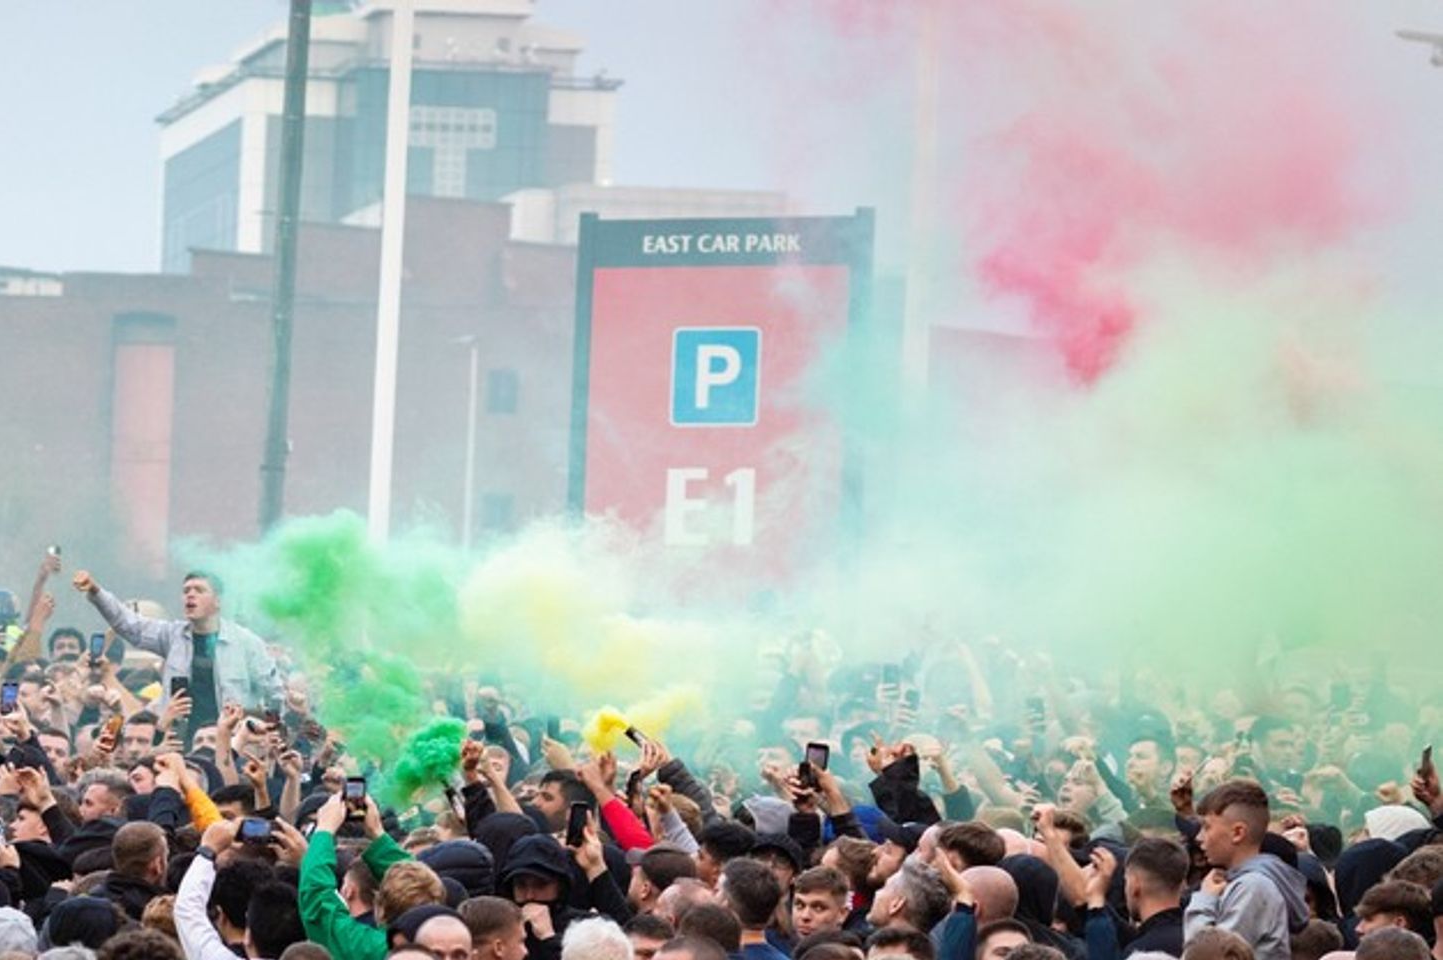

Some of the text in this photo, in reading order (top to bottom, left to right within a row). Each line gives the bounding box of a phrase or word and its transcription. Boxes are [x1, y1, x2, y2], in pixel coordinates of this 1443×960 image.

[643, 234, 801, 253] EAST CAR PARK
[664, 467, 756, 546] E1
